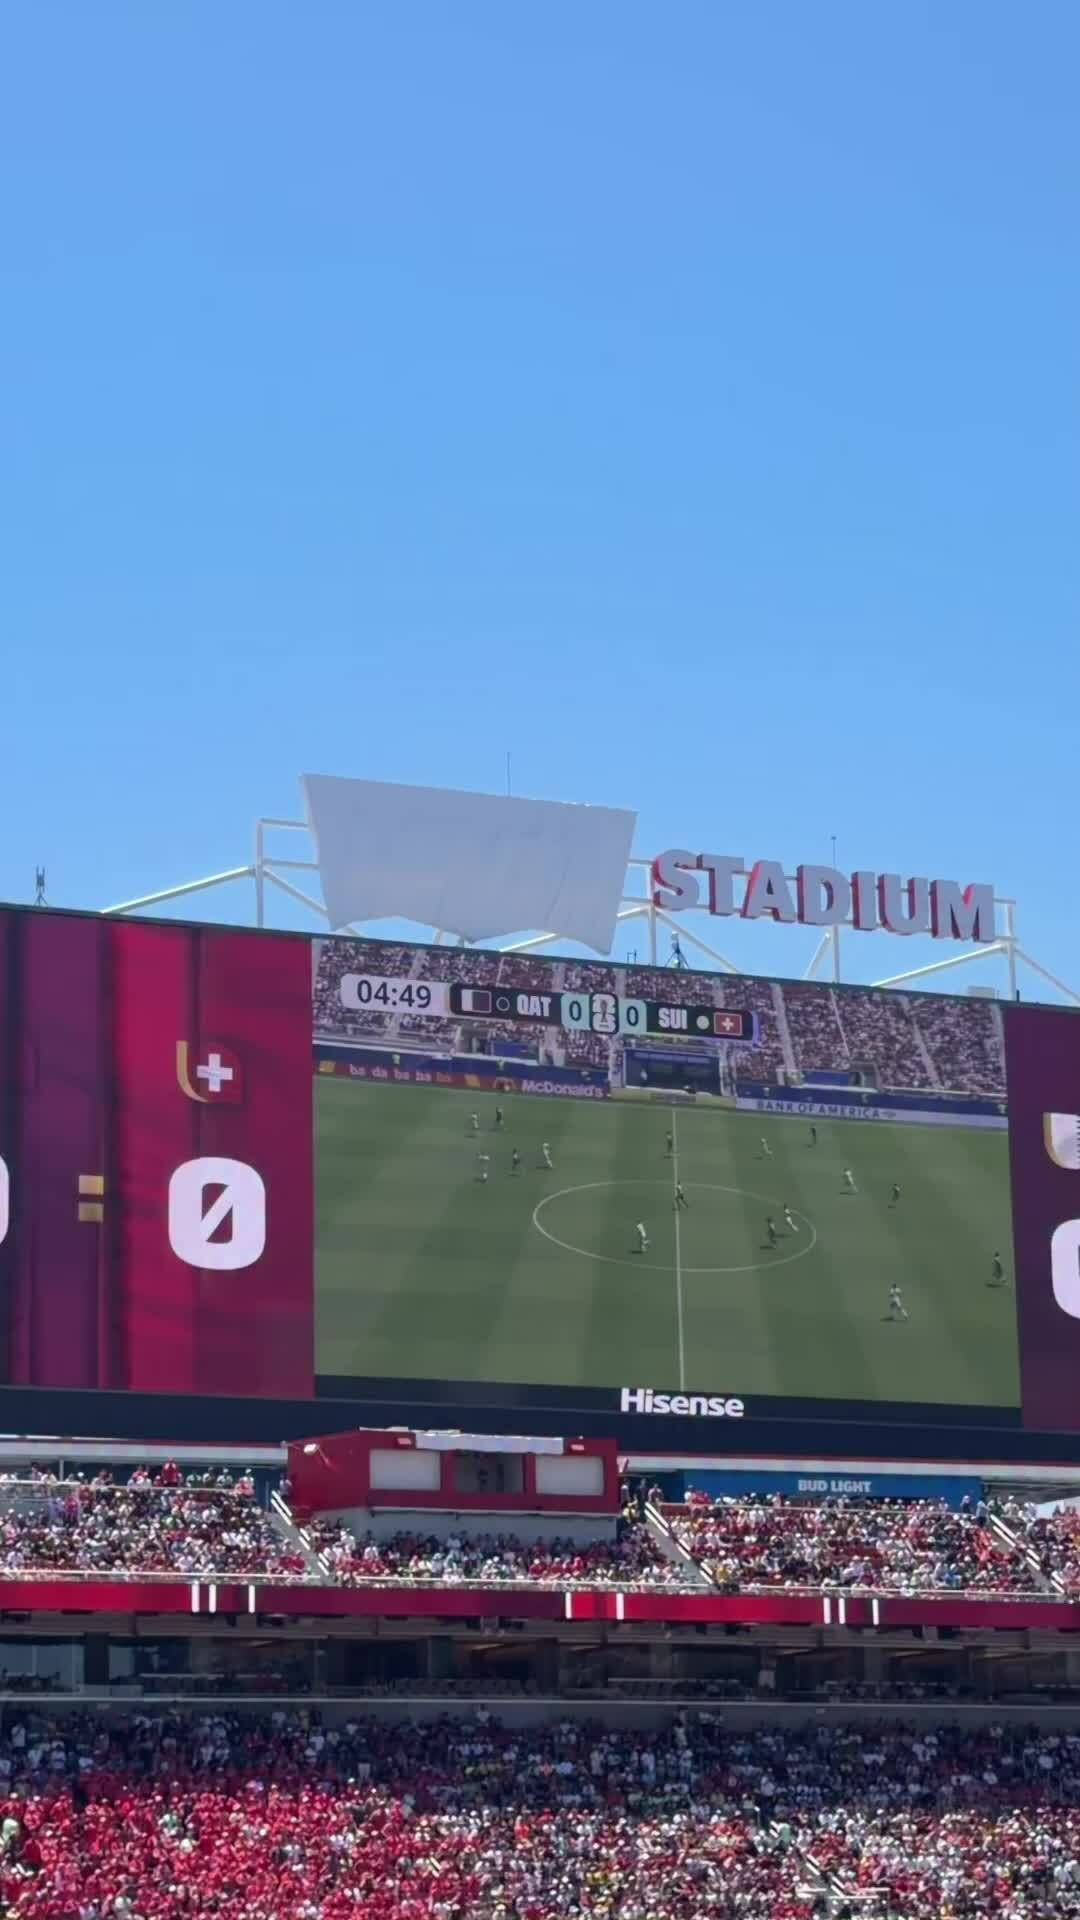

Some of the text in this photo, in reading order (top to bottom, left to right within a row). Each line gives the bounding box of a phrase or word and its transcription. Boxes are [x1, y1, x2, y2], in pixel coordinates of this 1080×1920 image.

[653, 849, 996, 942] STADIUM
[356, 979, 432, 1009] 04:49
[516, 994, 552, 1017] QAT
[568, 1000, 583, 1022] 0
[625, 1005, 640, 1027] 0
[658, 1007, 689, 1030] SUI
[521, 1079, 604, 1098] McDonald's
[756, 1101, 880, 1119] BANK OF AMERICA
[168, 1157, 266, 1270] 0
[620, 1387, 744, 1418] Hisense
[798, 1479, 872, 1493] BUD LIGHT
